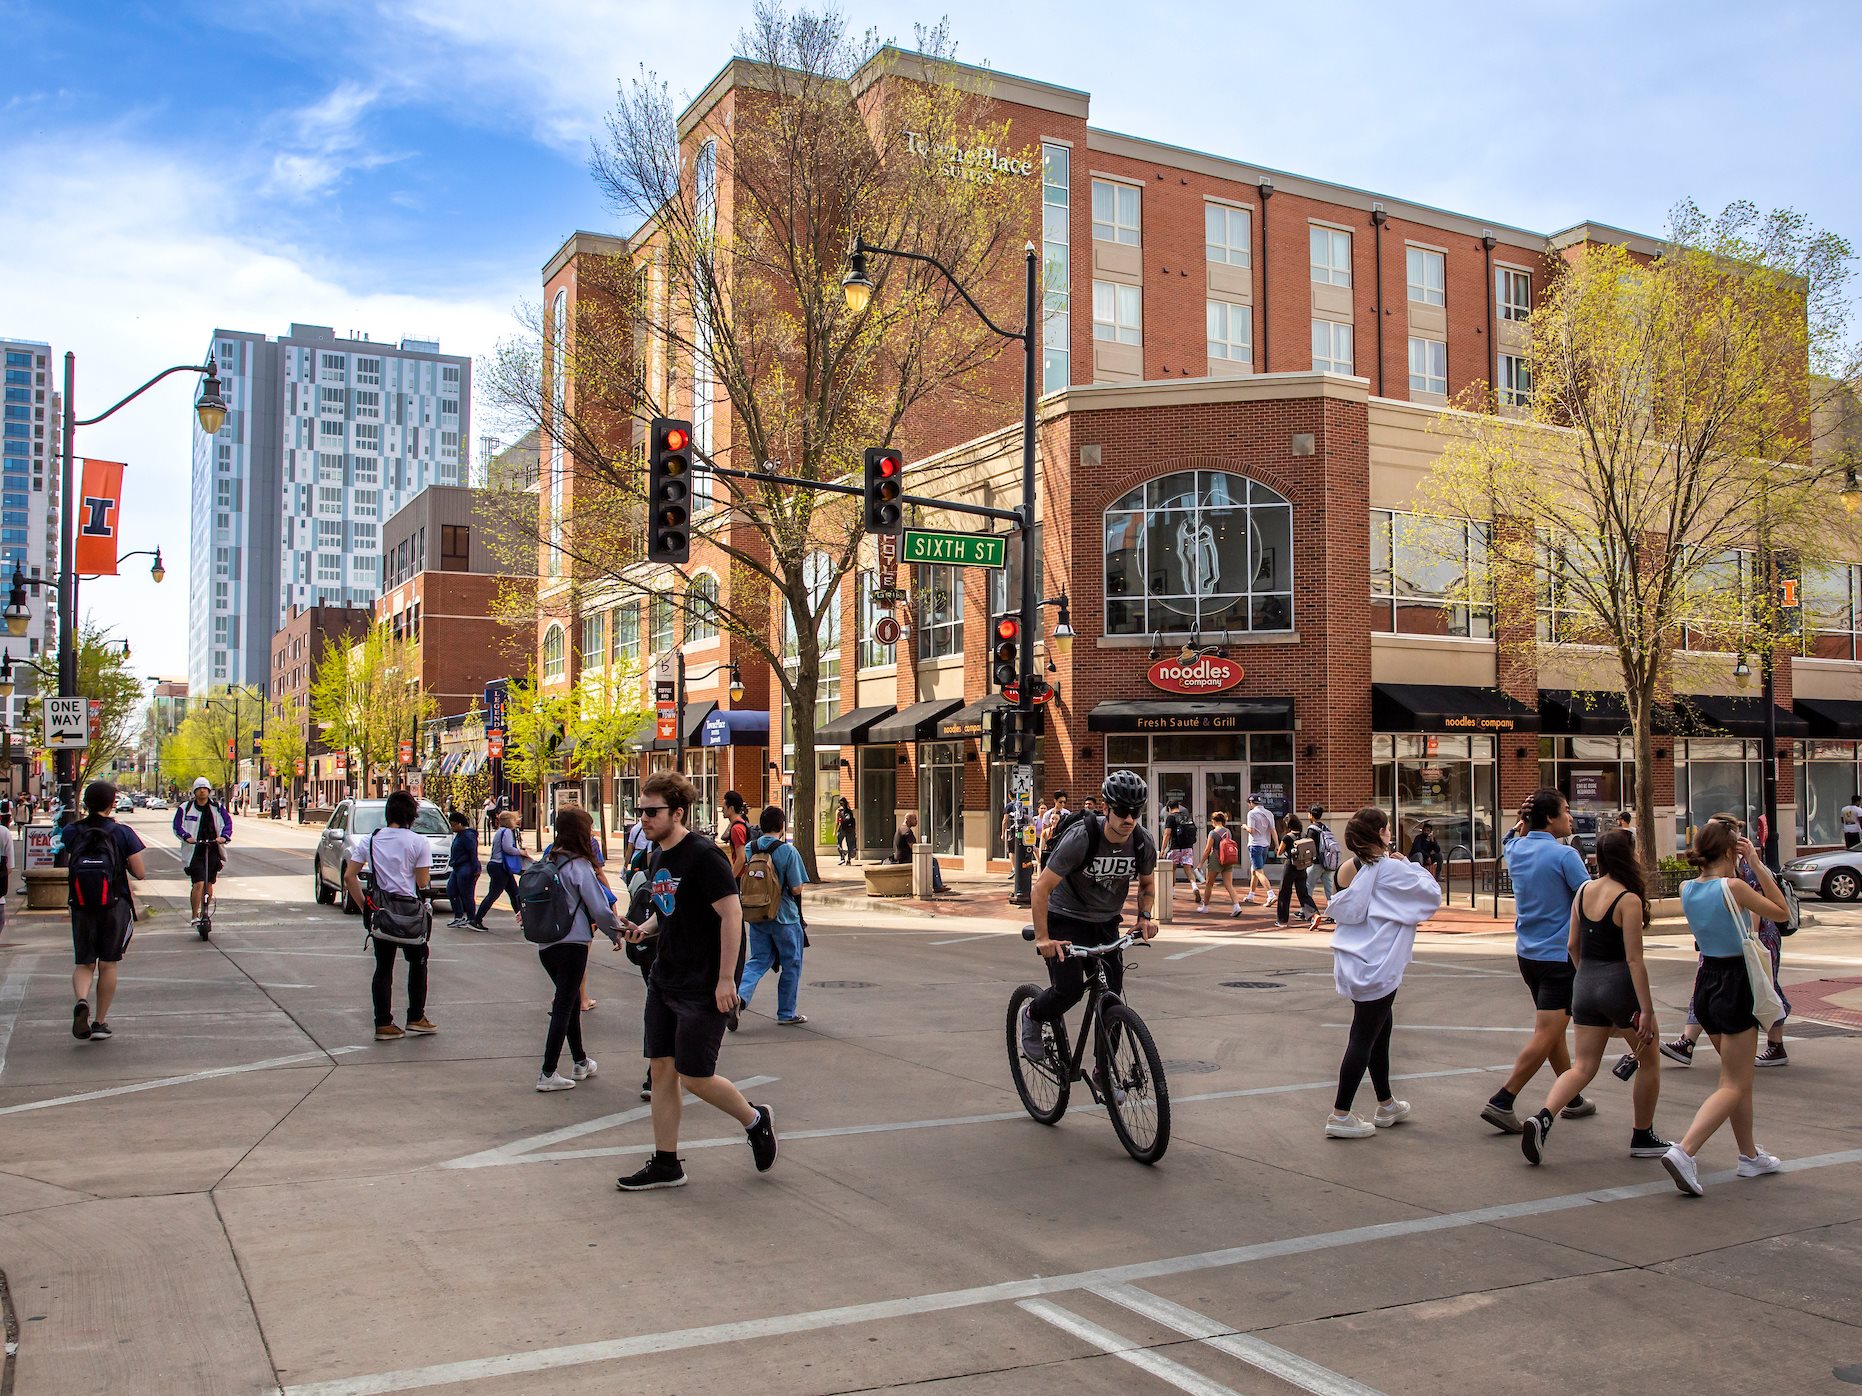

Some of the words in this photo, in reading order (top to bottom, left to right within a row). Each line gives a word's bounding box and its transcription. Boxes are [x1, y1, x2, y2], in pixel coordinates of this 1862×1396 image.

[82, 496, 115, 537] I
[915, 537, 965, 559] SIXTH
[975, 542, 995, 561] ST
[1160, 660, 1231, 680] noodles
[51, 701, 80, 712] ONE
[493, 691, 501, 731] LEGEND
[51, 714, 82, 726] WAY
[1137, 718, 1167, 727] Fresh
[1170, 717, 1199, 727] Sauté
[1203, 717, 1210, 727] &
[1213, 717, 1236, 727] Grill
[1445, 716, 1475, 727] noodles
[1481, 719, 1514, 730] company
[964, 725, 982, 735] compa
[1087, 858, 1136, 875] CUBS
